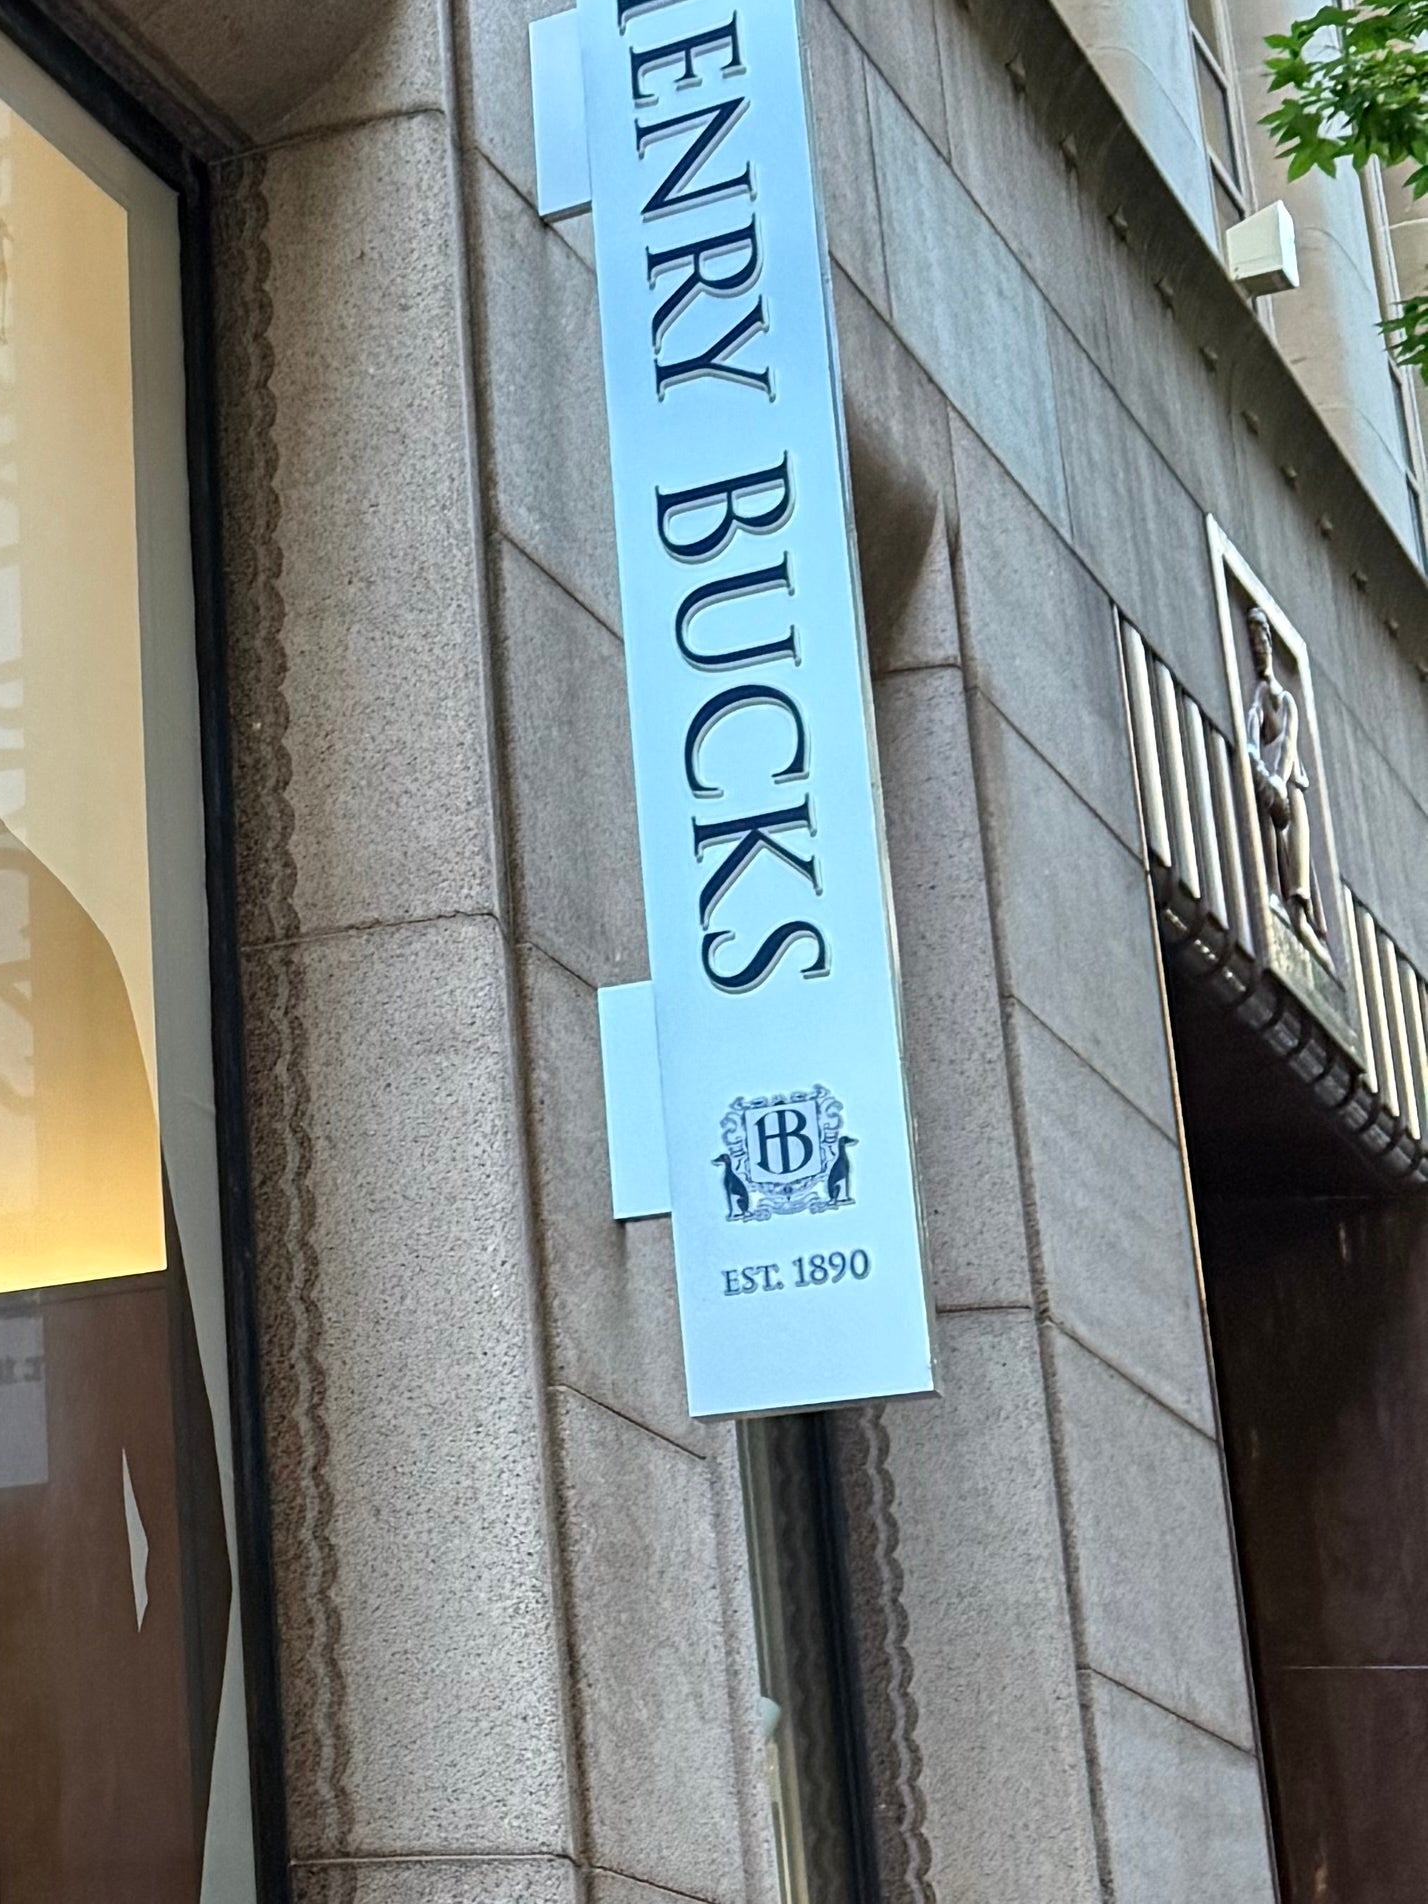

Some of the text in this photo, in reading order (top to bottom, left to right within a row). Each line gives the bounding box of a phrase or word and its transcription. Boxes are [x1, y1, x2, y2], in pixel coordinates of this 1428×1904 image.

[655, 450, 831, 994] BUCKS
[721, 1249, 871, 1296] EST. 1890
